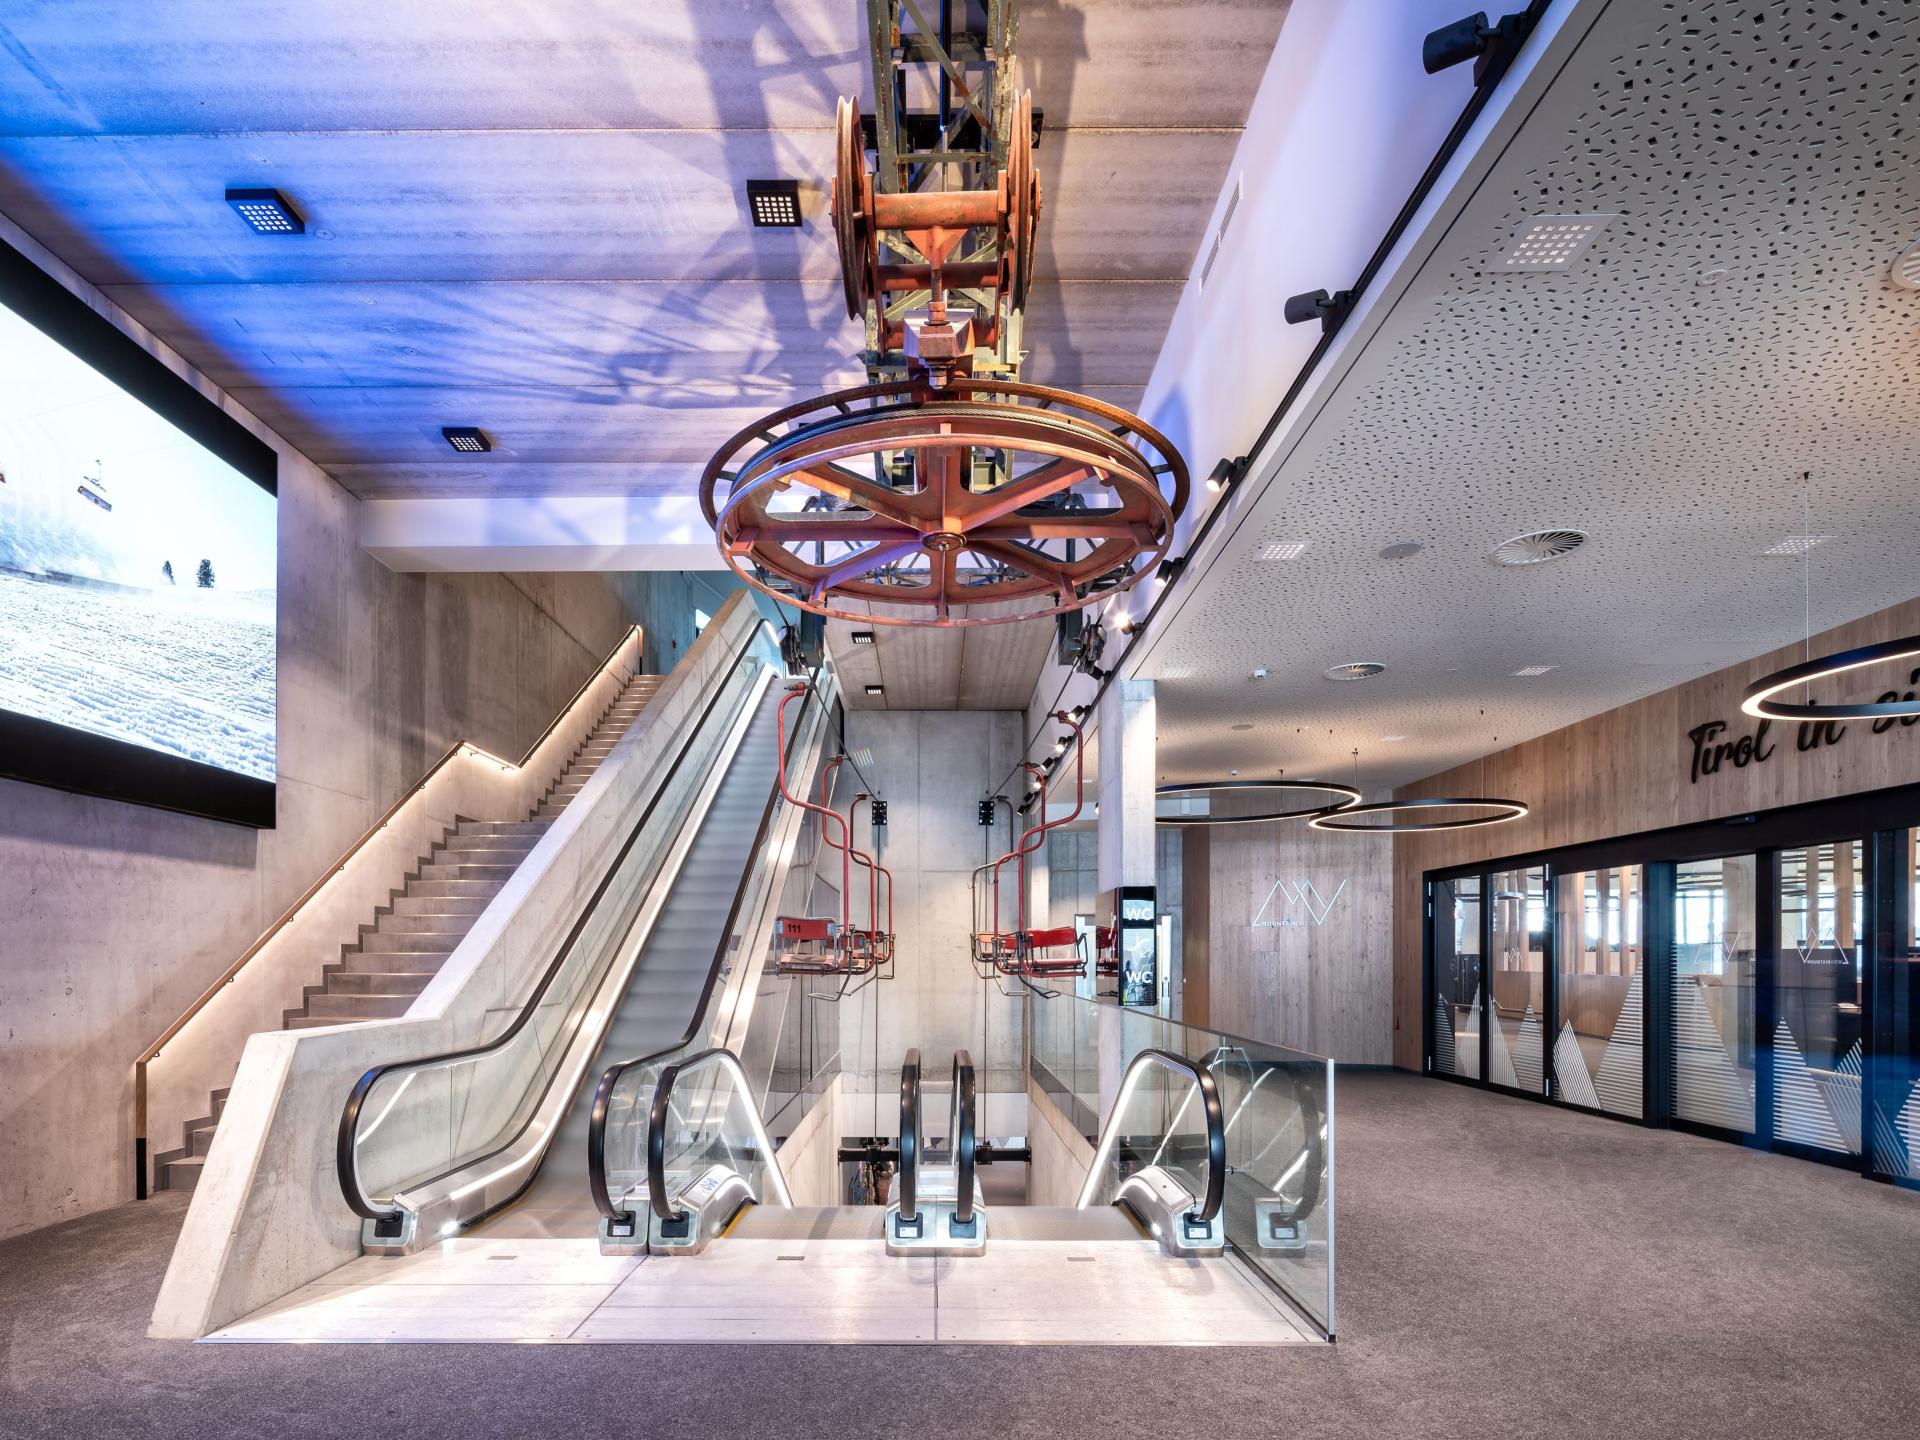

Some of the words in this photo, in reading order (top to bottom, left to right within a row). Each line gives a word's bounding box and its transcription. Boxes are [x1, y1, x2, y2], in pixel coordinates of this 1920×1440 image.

[1688, 717, 1776, 784] Tirol
[1797, 700, 1847, 752] in
[1125, 907, 1153, 921] WC
[787, 924, 801, 933] 111
[1126, 970, 1153, 983] WC
